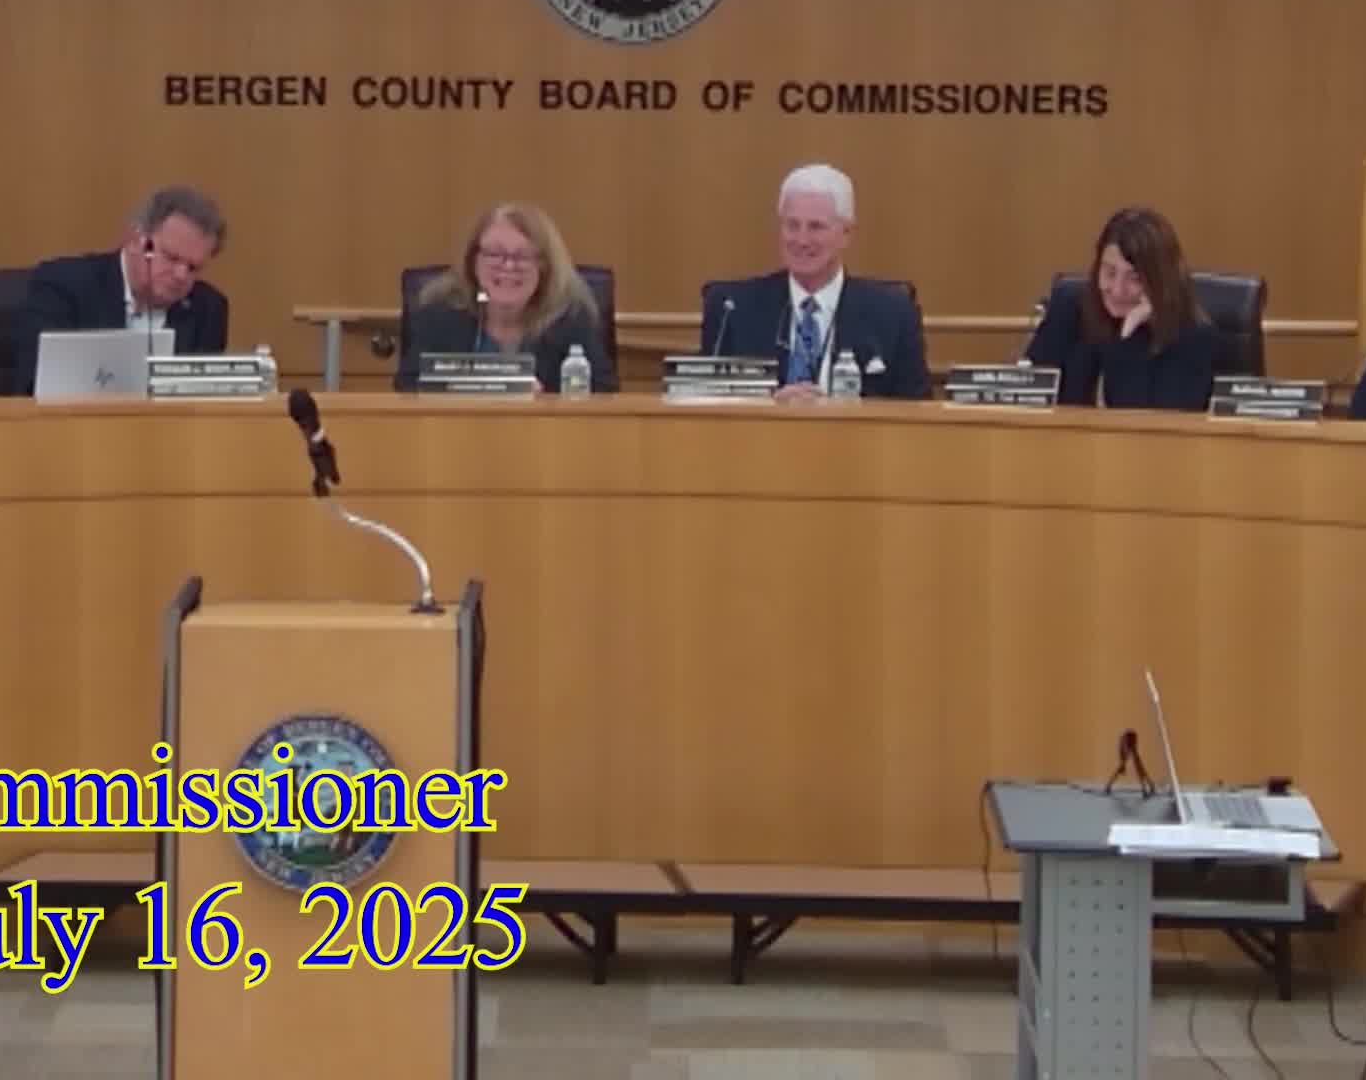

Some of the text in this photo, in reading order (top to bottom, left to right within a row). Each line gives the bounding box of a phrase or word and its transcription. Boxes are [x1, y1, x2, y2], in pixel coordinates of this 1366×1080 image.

[623, 0, 703, 39] JERSEY
[164, 75, 1109, 117] BERGEN COUNTY BOARD OF COMMISSIONERS
